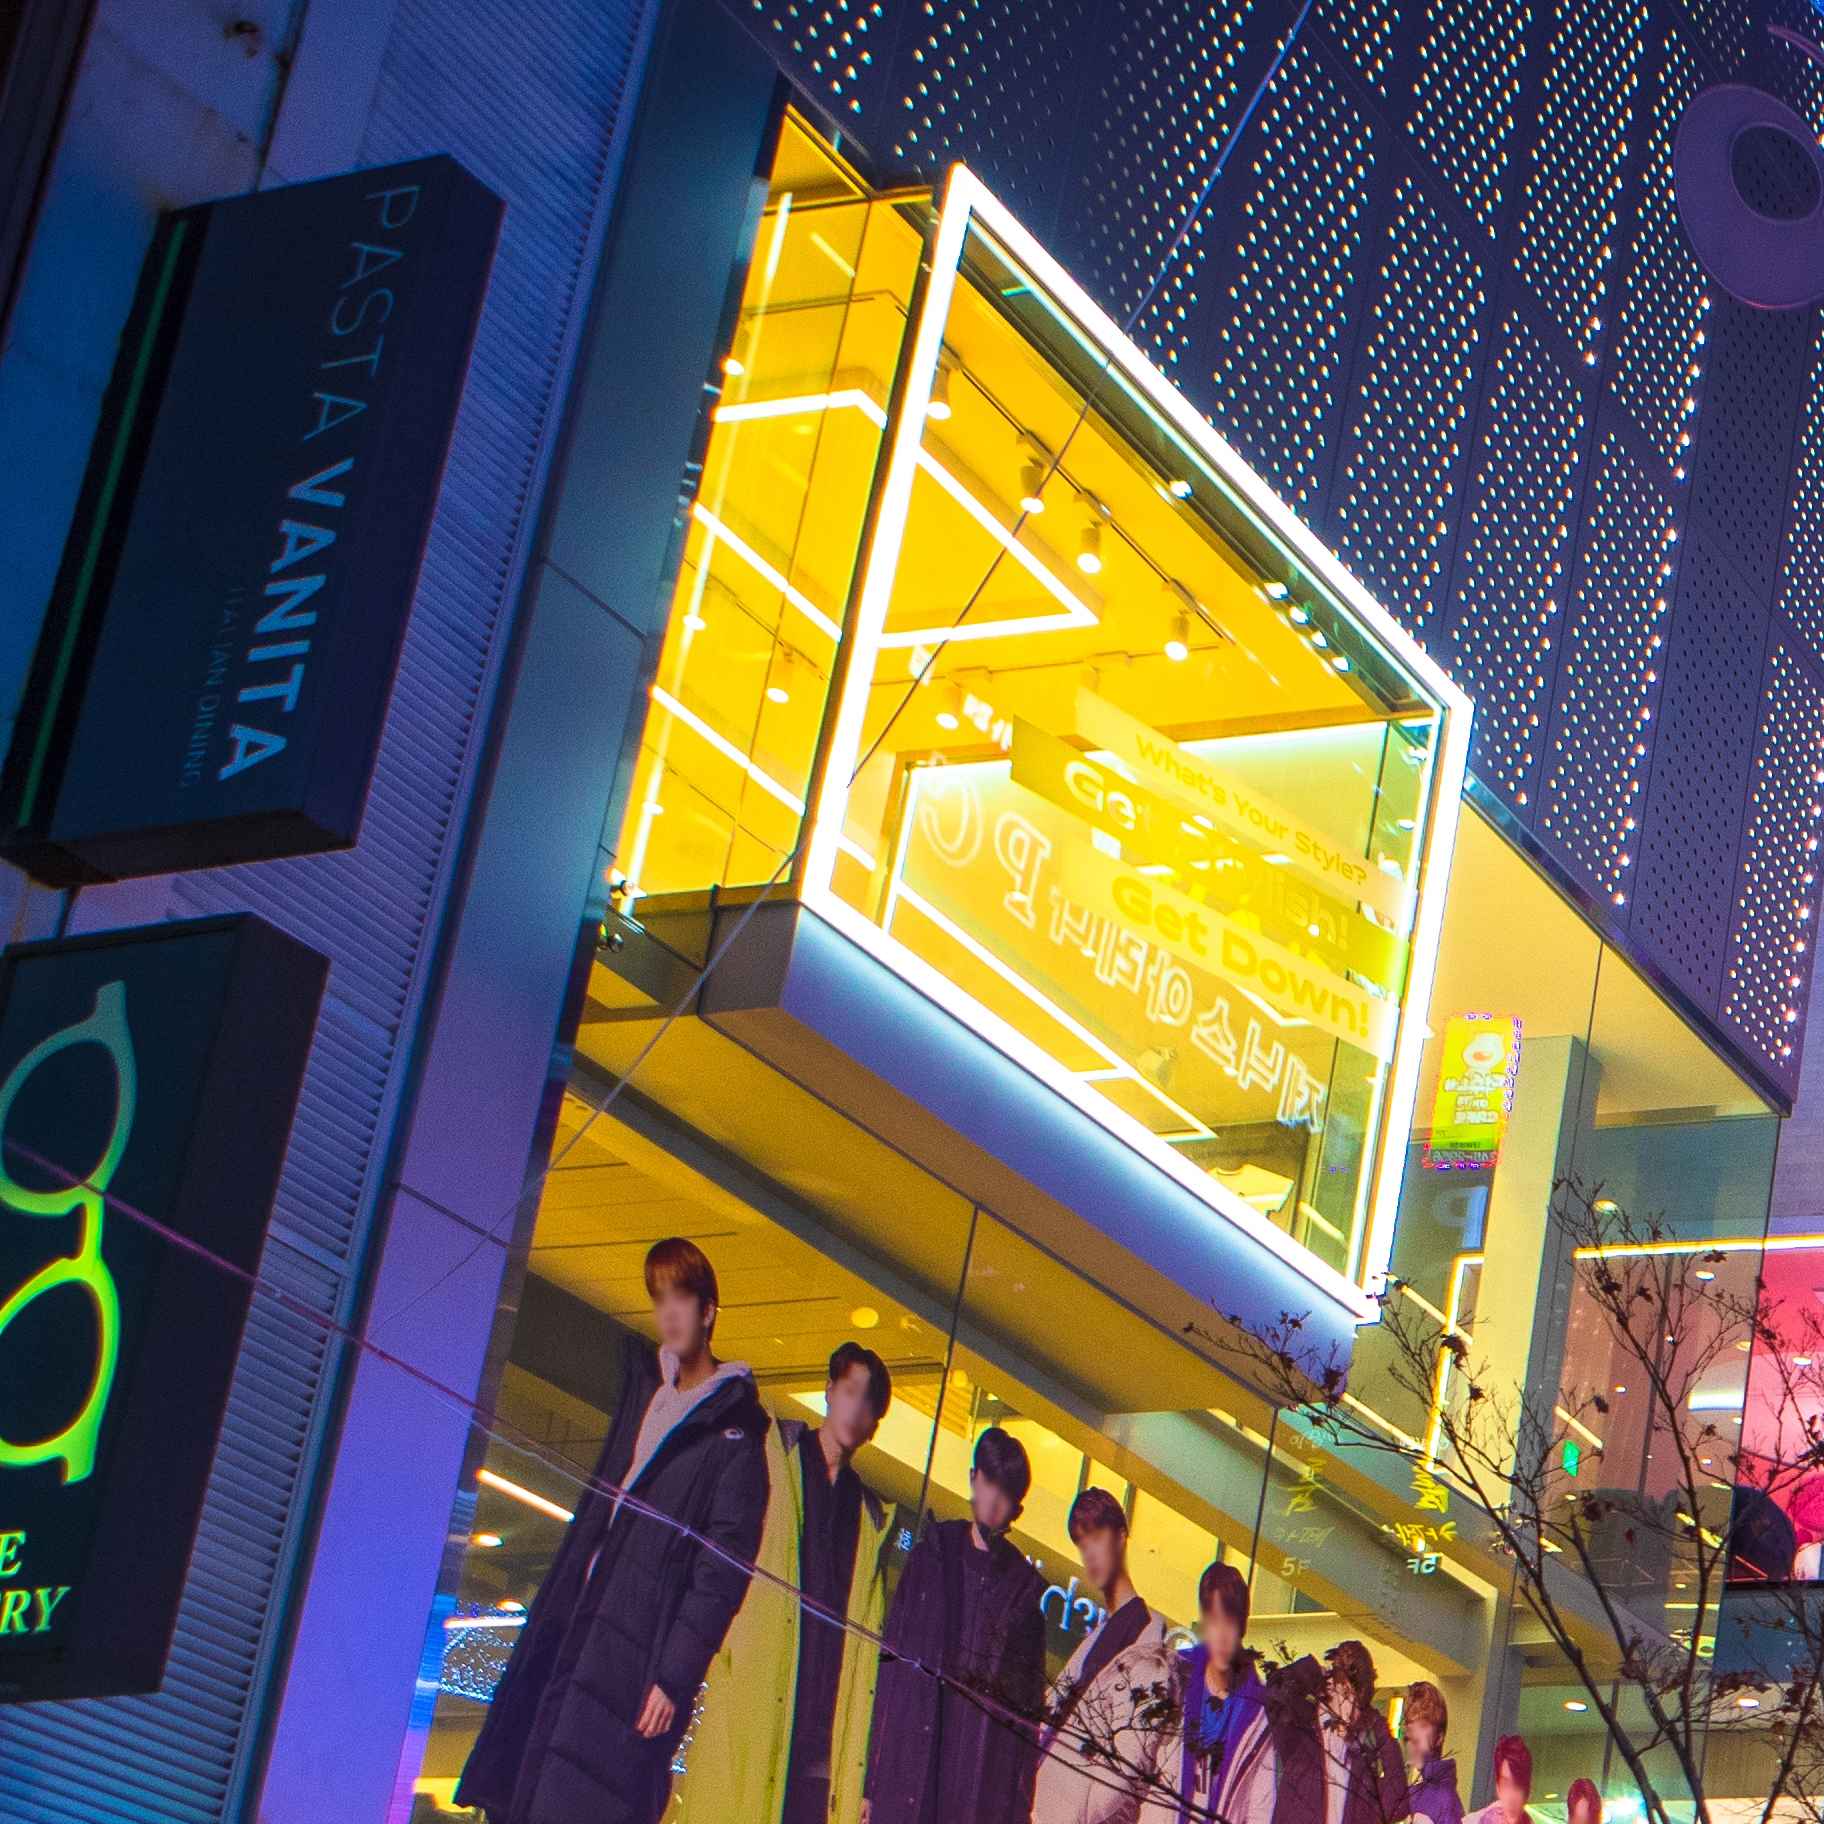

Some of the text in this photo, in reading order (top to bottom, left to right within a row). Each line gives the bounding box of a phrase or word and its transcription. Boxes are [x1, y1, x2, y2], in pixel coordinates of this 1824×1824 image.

[219, 184, 422, 782] PASTA VANITA
[1134, 733, 1225, 799] What's
[1294, 825, 1367, 887] Style?
[1109, 871, 1208, 957] Get
[1218, 920, 1368, 1038] Down!
